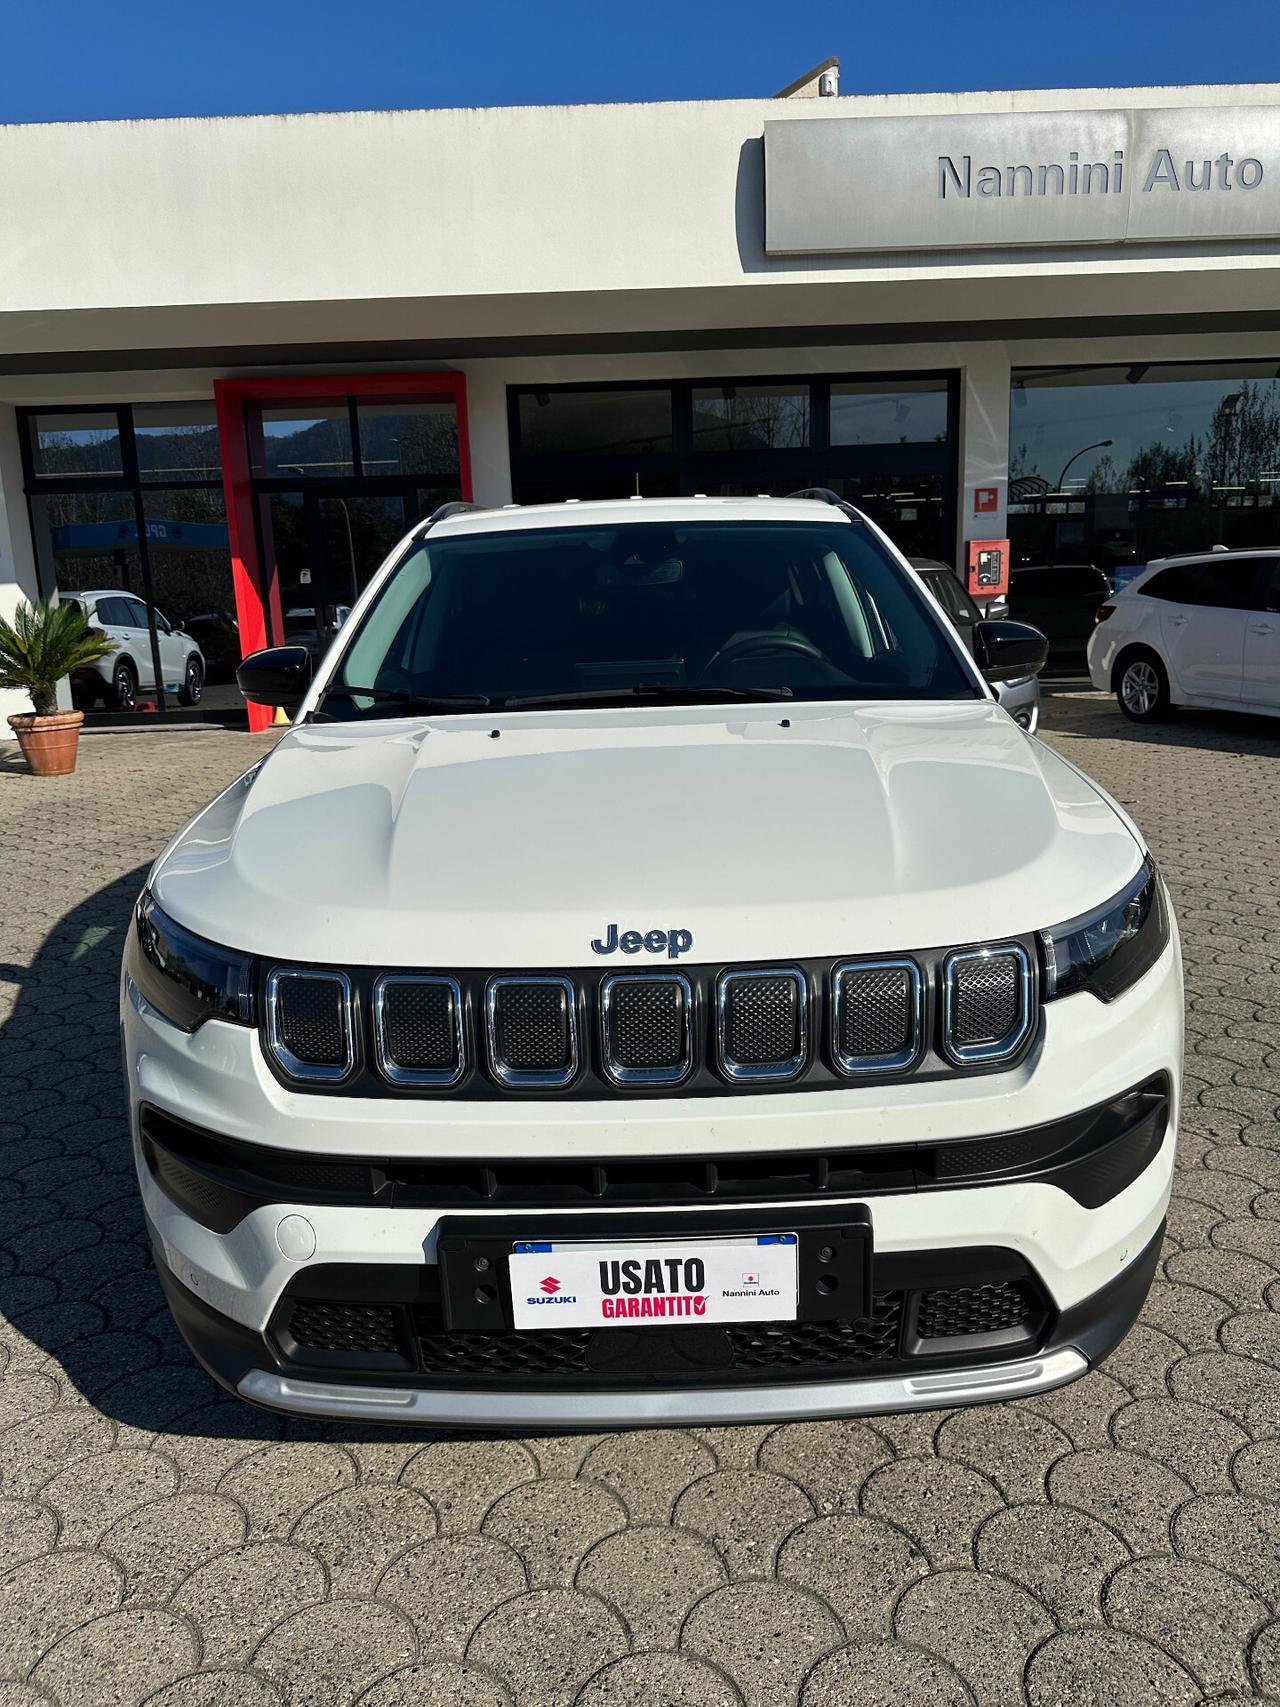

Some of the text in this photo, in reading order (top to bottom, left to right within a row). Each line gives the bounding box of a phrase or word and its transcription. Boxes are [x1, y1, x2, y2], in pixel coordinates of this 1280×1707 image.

[938, 149, 1264, 199] Nannini Auto
[591, 924, 693, 958] Jeep
[599, 1258, 705, 1295] USATO
[527, 1296, 577, 1305] SUZUKI
[602, 1295, 707, 1319] GARANTITO
[722, 1289, 757, 1297] Nannini
